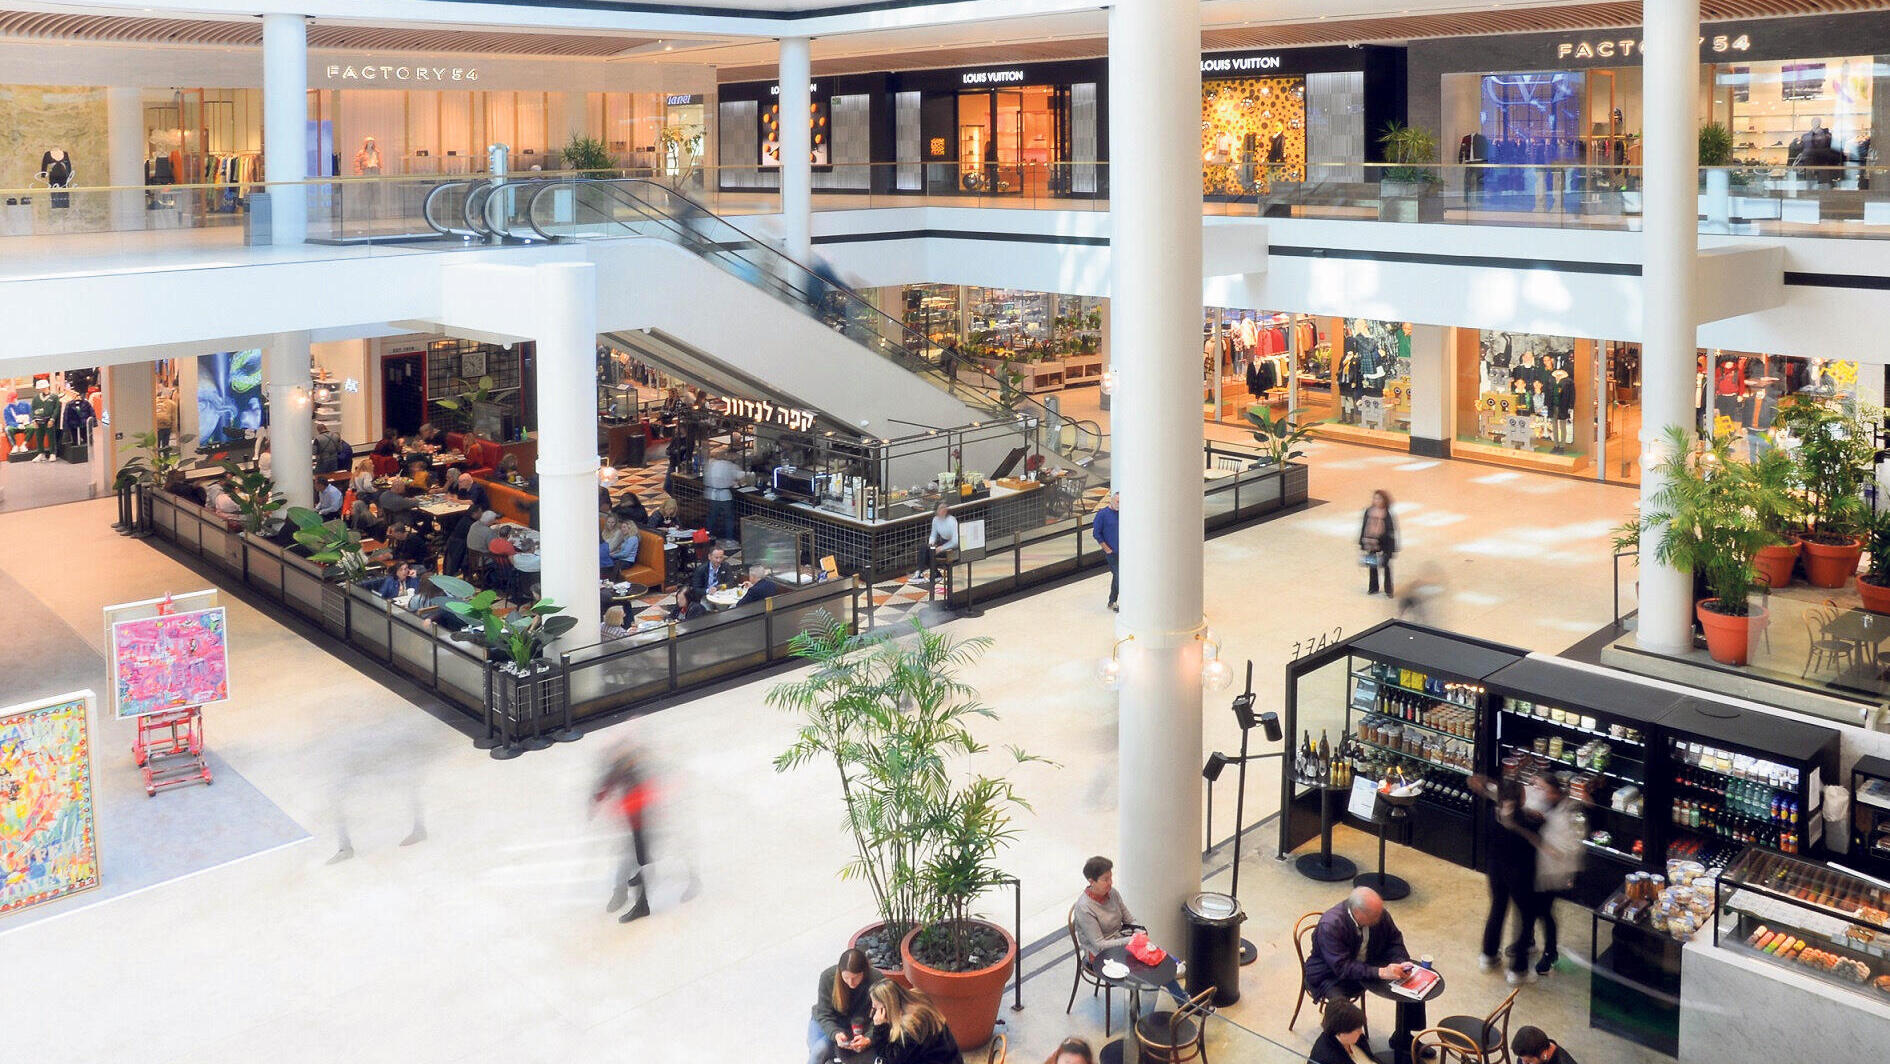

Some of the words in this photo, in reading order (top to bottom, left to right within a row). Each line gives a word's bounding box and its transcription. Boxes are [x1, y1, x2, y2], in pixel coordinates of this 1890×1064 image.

[1558, 37, 1704, 59] FACT
[1713, 34, 1751, 52] 54
[327, 64, 446, 81] FACTORY
[451, 67, 479, 82] 54
[1200, 58, 1231, 72] LOUIS
[1231, 56, 1280, 70] VUITTON
[962, 72, 987, 84] LOUIS
[987, 70, 1024, 83] VUITTON
[777, 406, 814, 432] קפה
